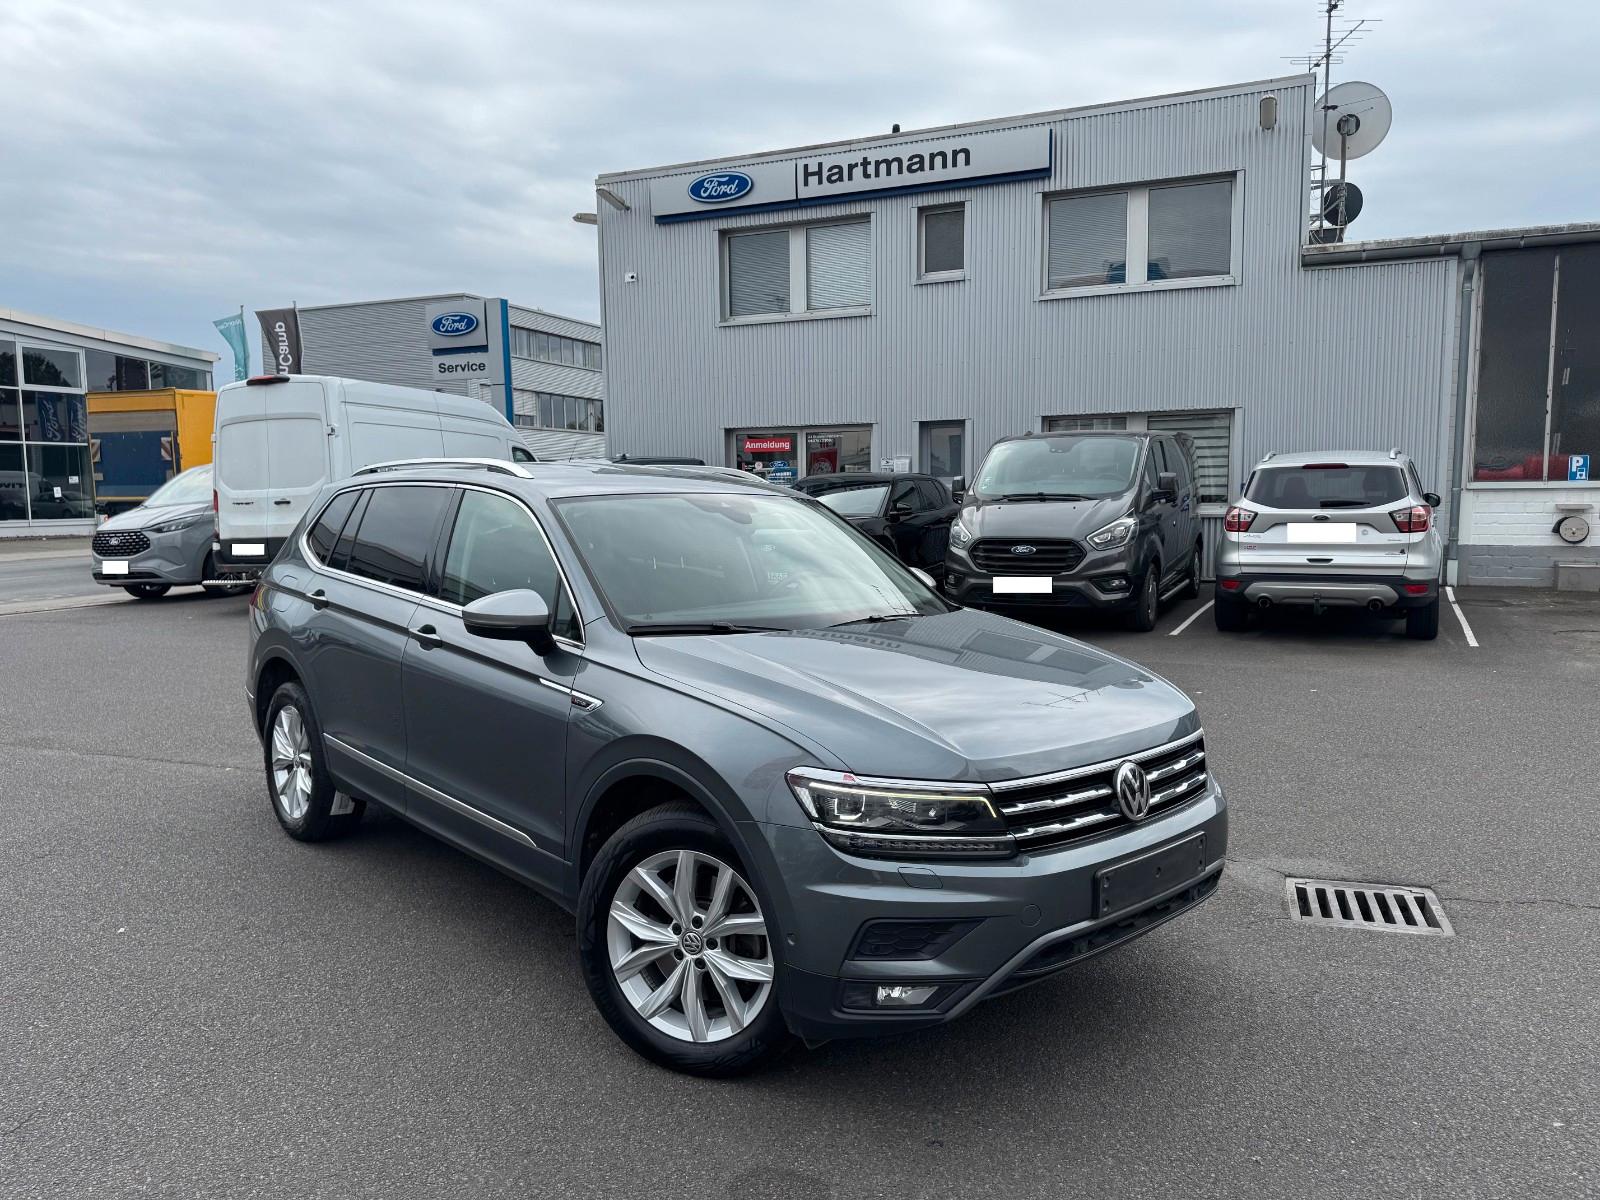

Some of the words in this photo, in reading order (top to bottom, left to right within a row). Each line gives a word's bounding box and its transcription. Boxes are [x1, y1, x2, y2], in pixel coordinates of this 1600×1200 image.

[803, 147, 971, 187] Hartmann
[700, 176, 739, 198] Ford
[439, 316, 468, 332] Ford
[438, 361, 486, 374] Service
[745, 441, 790, 449] Anmeldung
[1571, 456, 1584, 472] P
